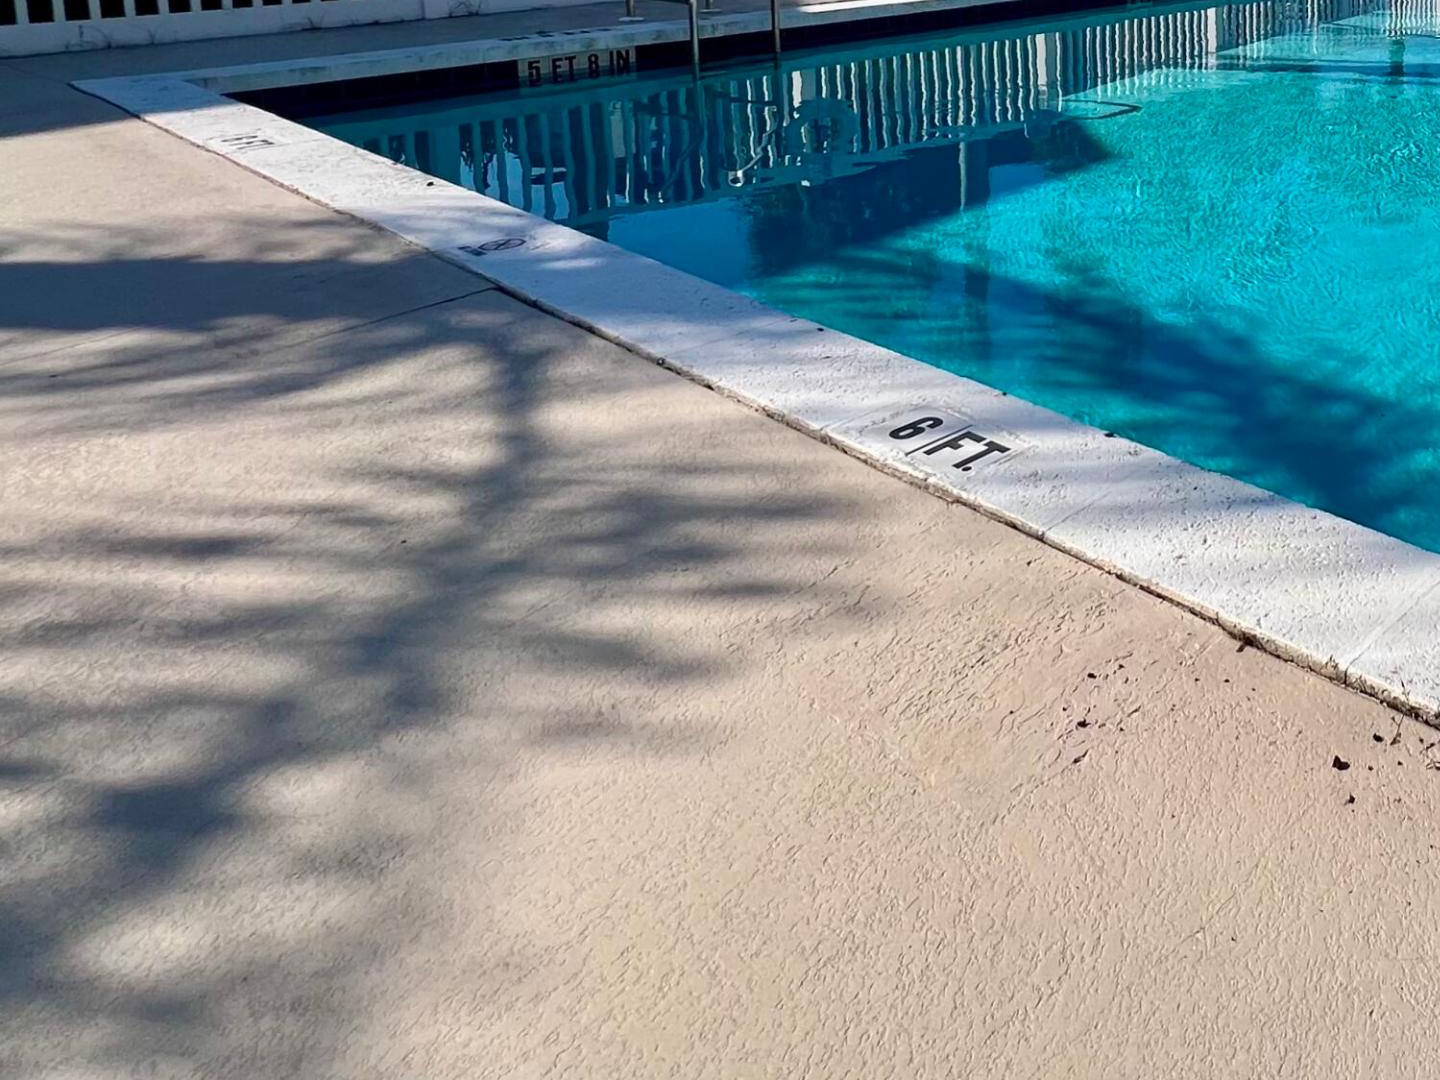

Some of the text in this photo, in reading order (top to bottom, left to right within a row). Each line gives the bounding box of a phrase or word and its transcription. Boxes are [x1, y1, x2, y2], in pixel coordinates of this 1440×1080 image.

[527, 60, 542, 87] 5
[588, 52, 600, 79] 8
[609, 49, 630, 75] IN
[888, 416, 944, 440] 6
